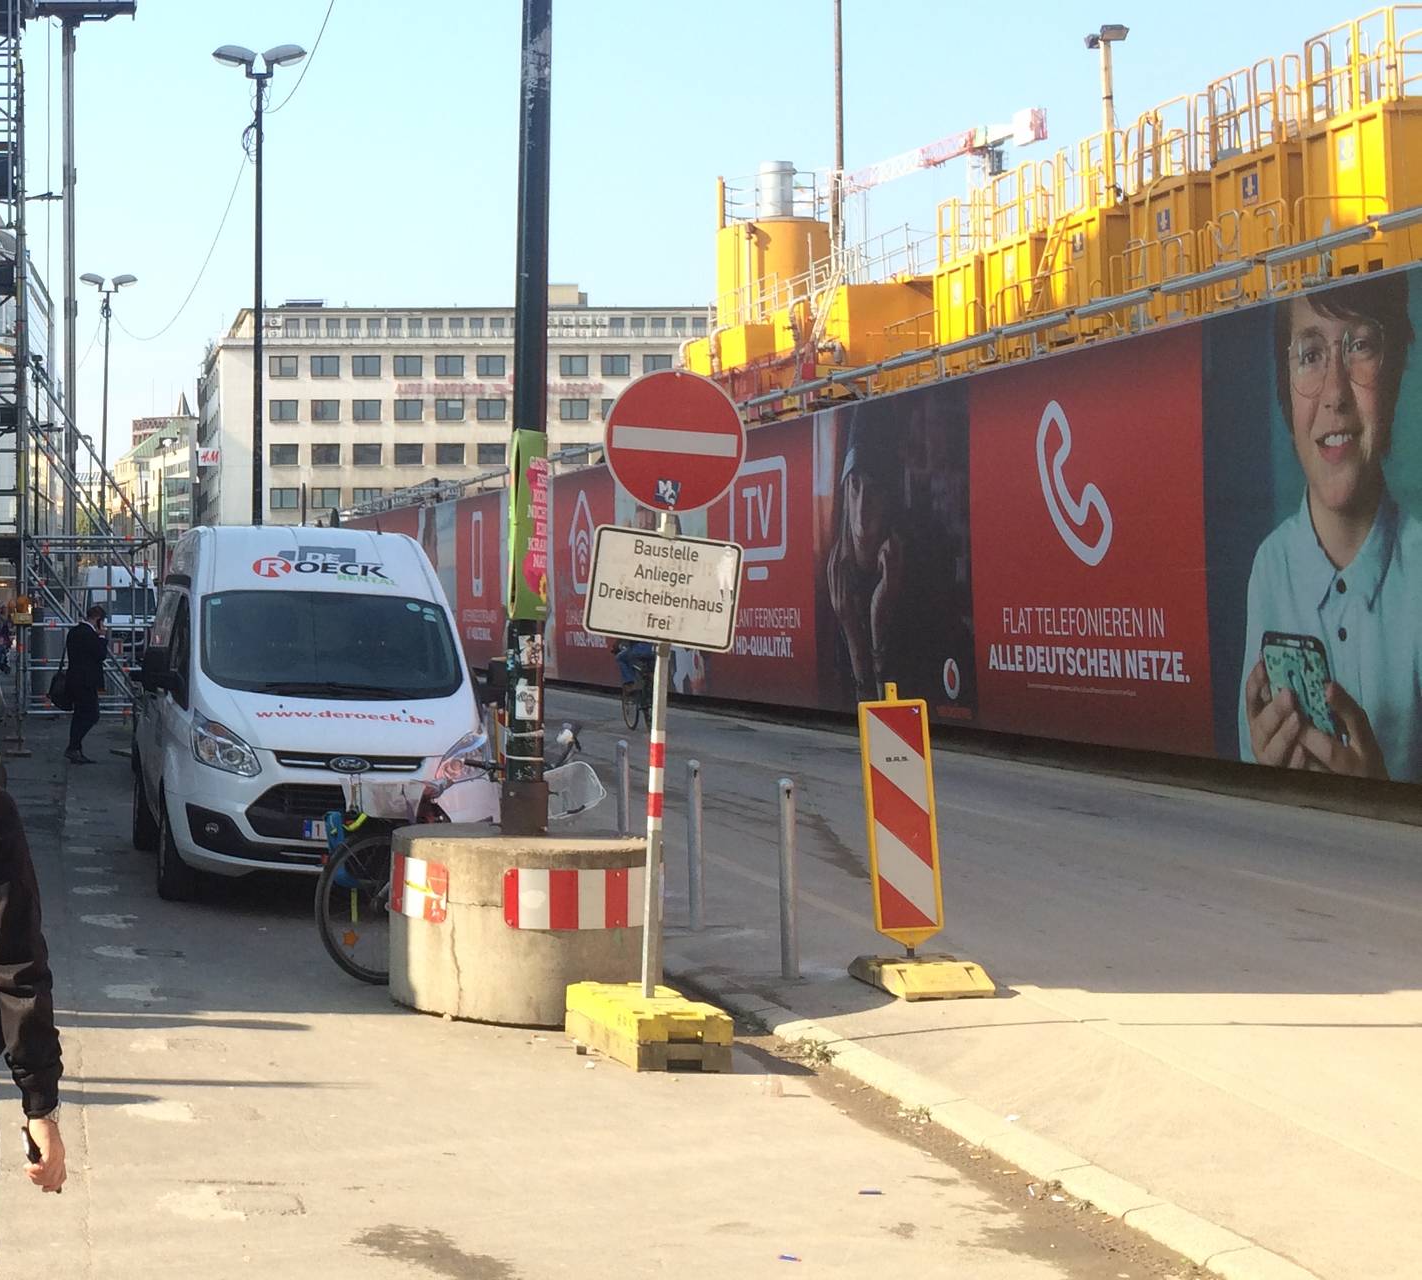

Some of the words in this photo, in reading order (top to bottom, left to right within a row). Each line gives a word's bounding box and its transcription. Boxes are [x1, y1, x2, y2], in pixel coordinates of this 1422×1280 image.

[741, 482, 774, 541] TV
[305, 552, 341, 563] DE
[633, 539, 700, 562] Baustelle
[633, 564, 695, 588] Anlieger
[598, 582, 724, 614] Dreischeibenhaus
[646, 613, 672, 631] frei
[754, 608, 801, 629] FERNSEHEN
[1002, 607, 1032, 635] FLAT
[1035, 607, 1145, 638] TELEFONIEREN
[1147, 607, 1166, 638] IN
[735, 630, 795, 659] HD-QUALITÄT.
[988, 643, 1027, 673] ALLE
[1025, 645, 1122, 679] DEUTSCHEN
[1126, 649, 1192, 684] NETZE.
[255, 710, 436, 727] www.deroeck.be
